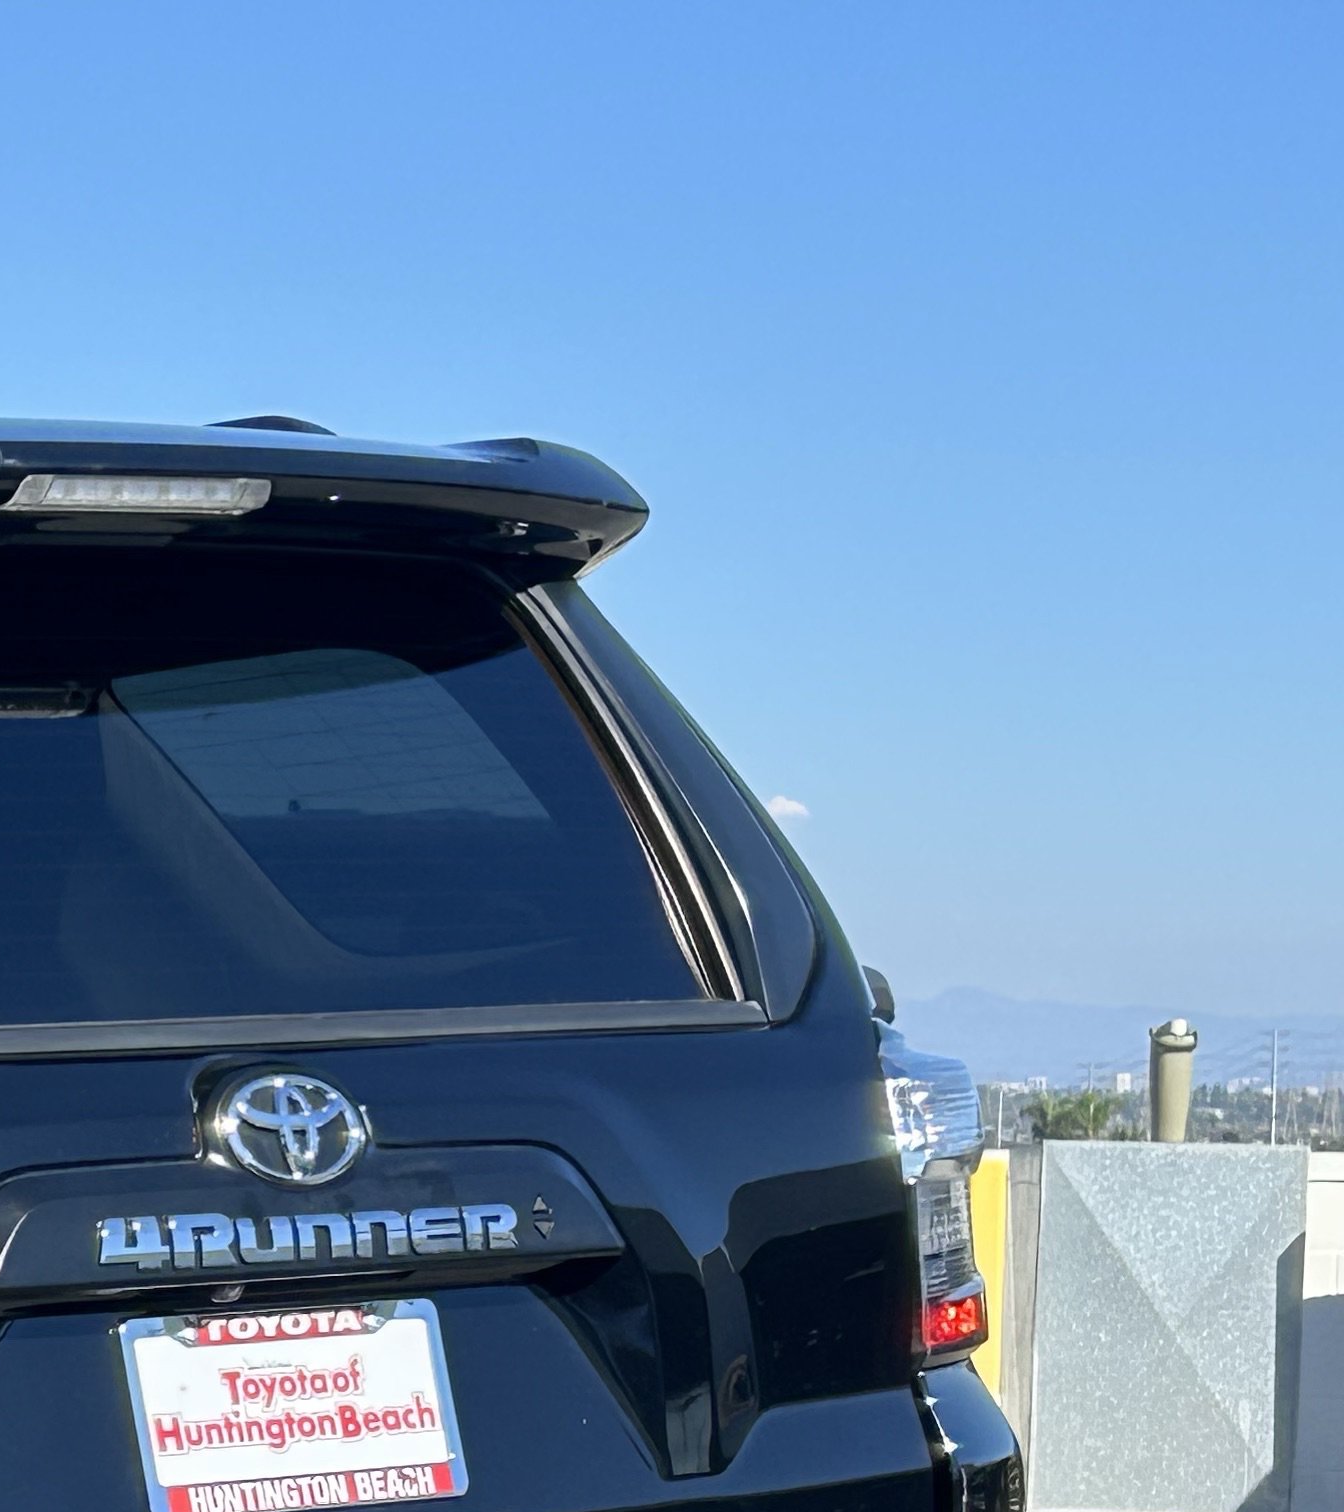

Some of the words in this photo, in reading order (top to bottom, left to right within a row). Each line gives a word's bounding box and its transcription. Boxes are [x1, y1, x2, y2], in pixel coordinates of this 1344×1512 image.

[205, 1310, 363, 1342] TOYOTA
[221, 1368, 328, 1409] Toyota
[331, 1357, 361, 1393] of
[155, 1411, 336, 1449] Huntington
[338, 1395, 436, 1439] Beach
[355, 1465, 437, 1501] BEACH
